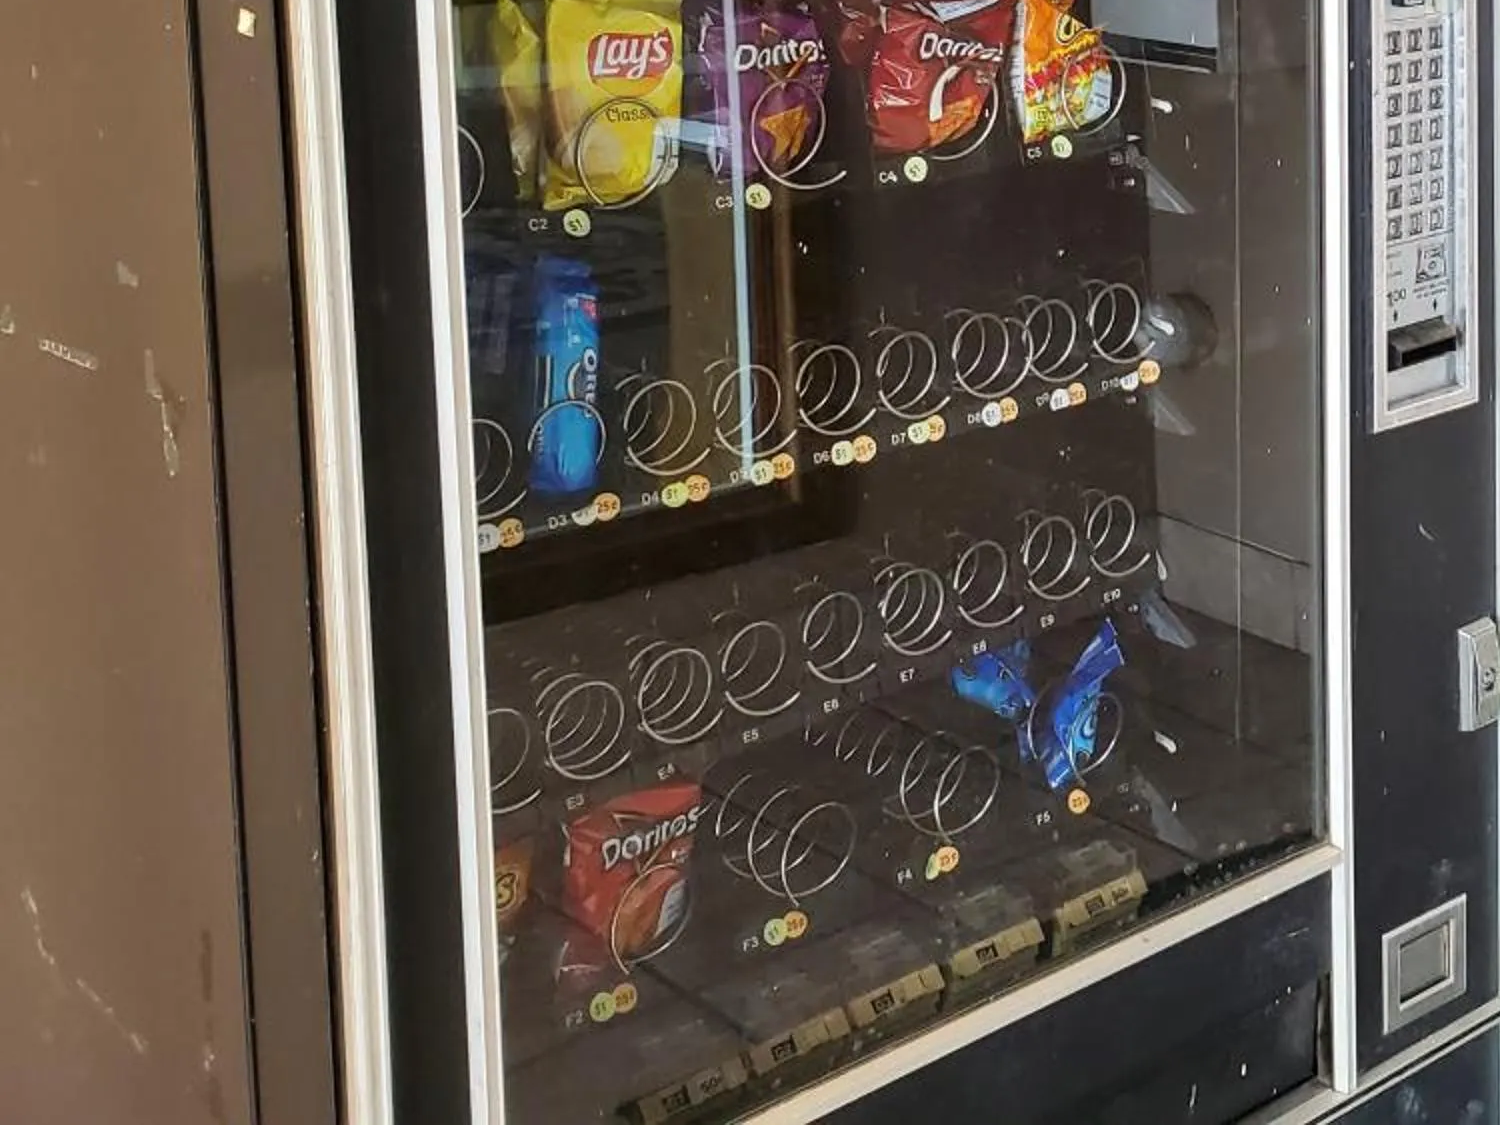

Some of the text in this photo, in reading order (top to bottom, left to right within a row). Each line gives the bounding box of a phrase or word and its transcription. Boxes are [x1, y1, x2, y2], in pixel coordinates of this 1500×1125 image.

[594, 31, 669, 80] Lay's
[605, 107, 652, 123] Class
[1027, 147, 1042, 159] C5
[715, 196, 734, 209] C3
[528, 218, 549, 231] C2
[891, 432, 906, 446] D7
[547, 515, 568, 530] D3
[900, 668, 915, 683] E7
[743, 728, 760, 744] E5
[565, 793, 585, 811] E3
[602, 806, 701, 871] Doritos
[743, 936, 760, 952] F3
[564, 1008, 584, 1029] F2
